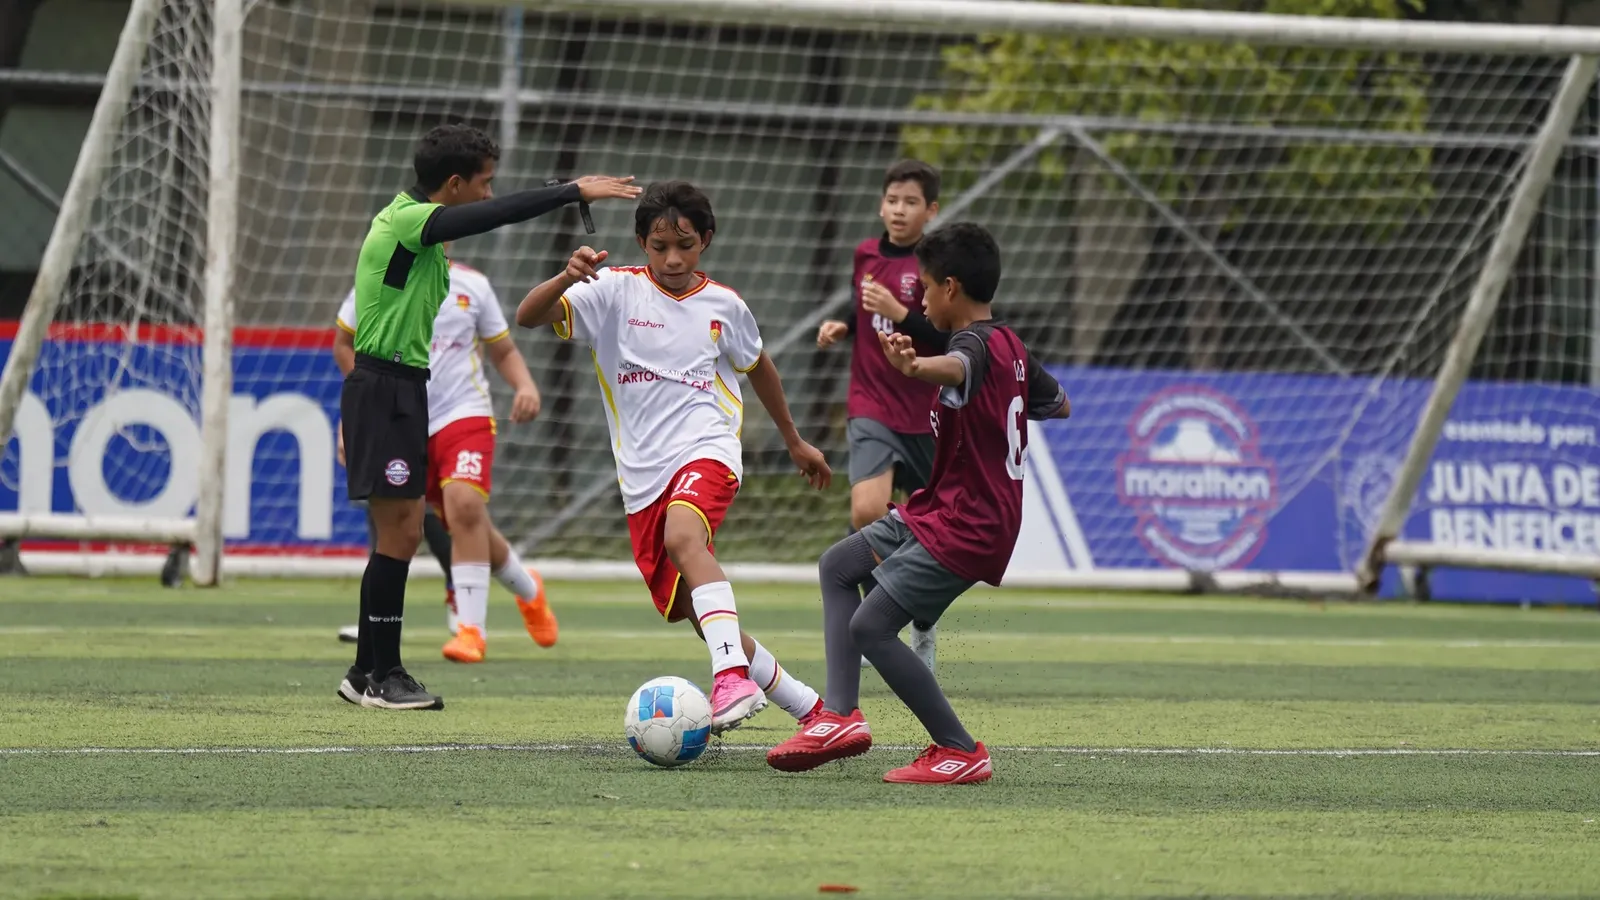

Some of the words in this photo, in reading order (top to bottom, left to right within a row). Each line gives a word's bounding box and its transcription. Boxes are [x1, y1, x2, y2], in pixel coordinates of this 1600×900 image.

[872, 313, 894, 335] 40
[456, 450, 483, 475] 25
[674, 471, 703, 492] 17
[1125, 466, 1271, 500] marathon
[1427, 462, 1550, 505] JUNTA
[1553, 465, 1600, 508] DE
[1430, 508, 1600, 552] BENEFICE
